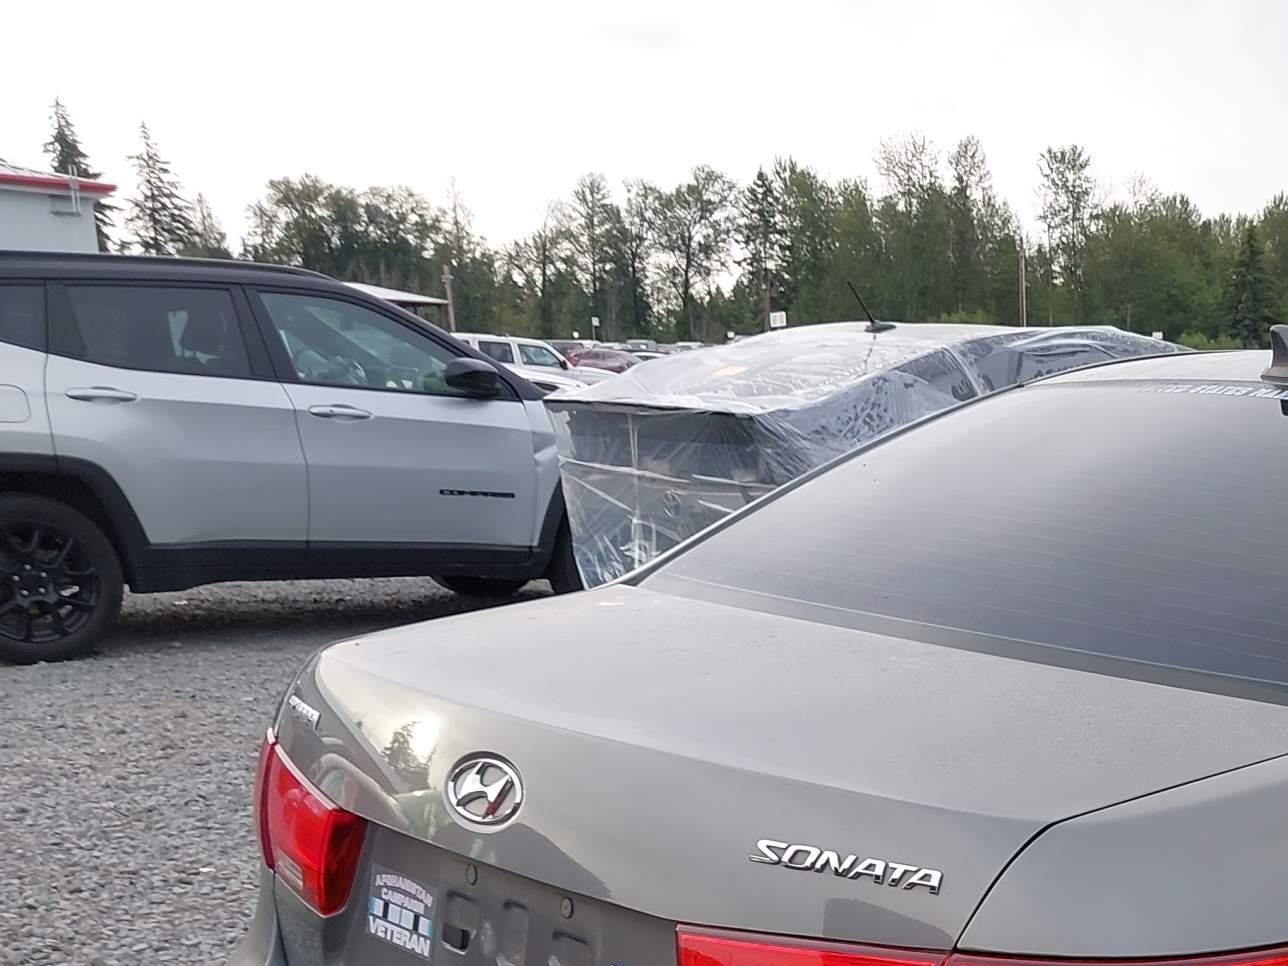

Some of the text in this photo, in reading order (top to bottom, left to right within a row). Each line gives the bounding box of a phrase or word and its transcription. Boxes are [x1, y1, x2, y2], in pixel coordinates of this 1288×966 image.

[1135, 384, 1193, 393] ITED
[749, 839, 945, 896] SONATA
[368, 914, 431, 957] VETERAN
